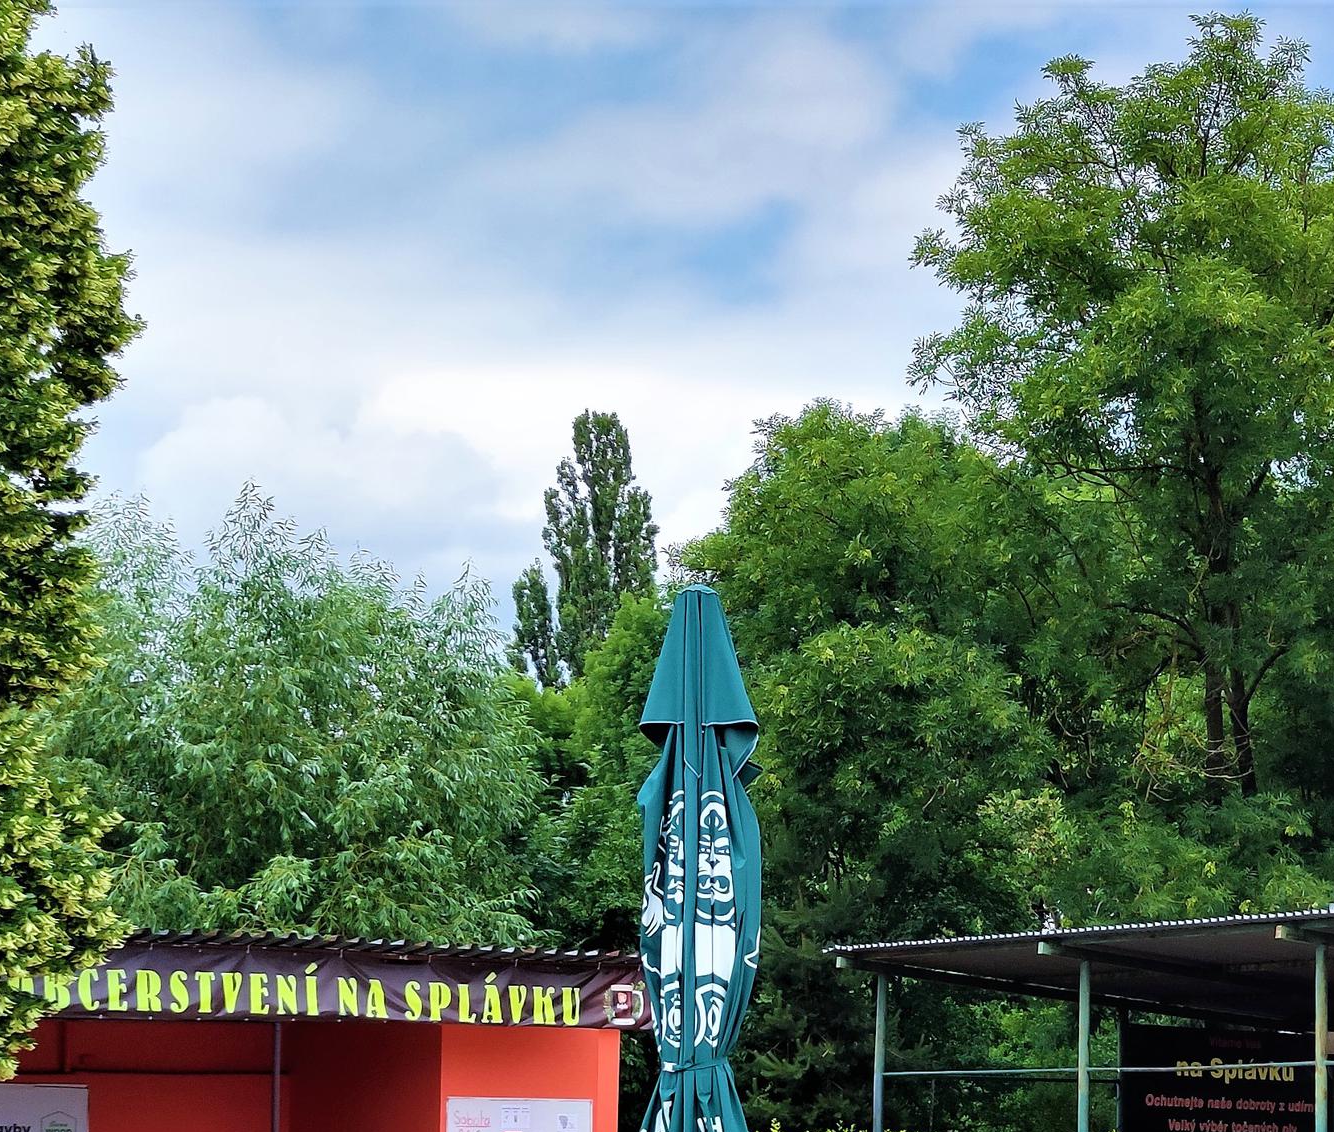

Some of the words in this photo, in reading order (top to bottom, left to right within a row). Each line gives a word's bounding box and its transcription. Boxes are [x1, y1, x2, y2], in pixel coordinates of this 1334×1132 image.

[336, 976, 389, 1019] NA
[404, 971, 582, 1027] SPLÁVKU
[1176, 1061, 1203, 1077] na
[1210, 1057, 1295, 1084] Splávku
[1145, 1094, 1204, 1111] Ochutnejte
[1207, 1097, 1233, 1110] naše
[1236, 1099, 1276, 1114] dobroty
[1279, 1102, 1285, 1112] z
